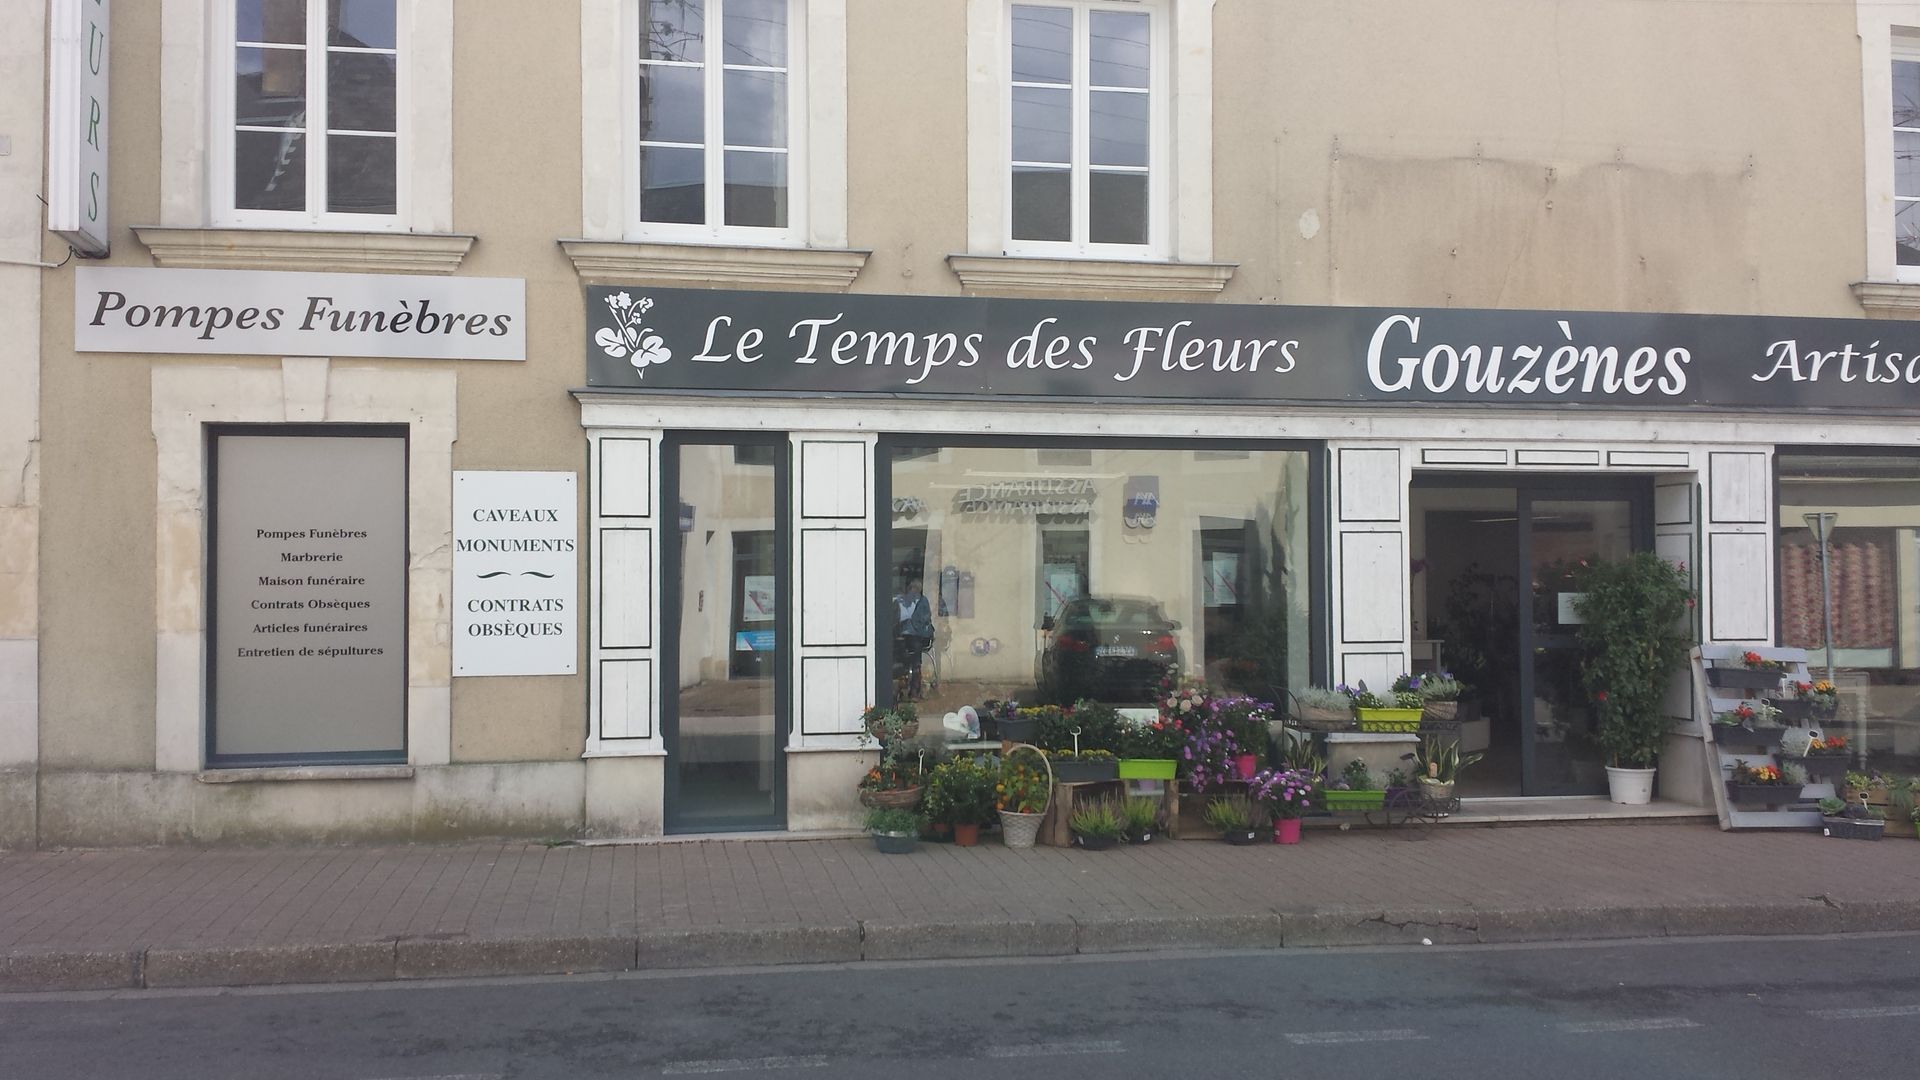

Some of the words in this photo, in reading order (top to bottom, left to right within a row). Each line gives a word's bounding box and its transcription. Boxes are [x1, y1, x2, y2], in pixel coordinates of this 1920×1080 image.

[87, 0, 104, 222] URS
[89, 289, 285, 341] Pompes
[298, 295, 513, 338] Funèbres
[690, 314, 765, 365] Le
[787, 311, 983, 386] Temps
[1004, 317, 1097, 371] des
[1111, 319, 1300, 382] Fleurs
[1365, 313, 1693, 396] Gouzènes
[473, 508, 559, 523] CAVEAUX
[256, 528, 306, 541] Pompes
[310, 528, 368, 539] Funèbres
[456, 538, 575, 553] MONUMENTS
[280, 552, 344, 563] Marbrerie
[258, 576, 304, 586] Maison
[307, 575, 366, 586] funéraire
[251, 599, 304, 610] Contrats
[308, 598, 371, 611] Obsèques
[467, 598, 564, 613] CONTRATS
[253, 623, 300, 633] Articles
[303, 622, 368, 633] funéraires
[468, 619, 564, 639] OBSÈQUES
[237, 646, 295, 657] Entretien
[298, 646, 315, 657] de
[318, 645, 384, 658] sépultures
